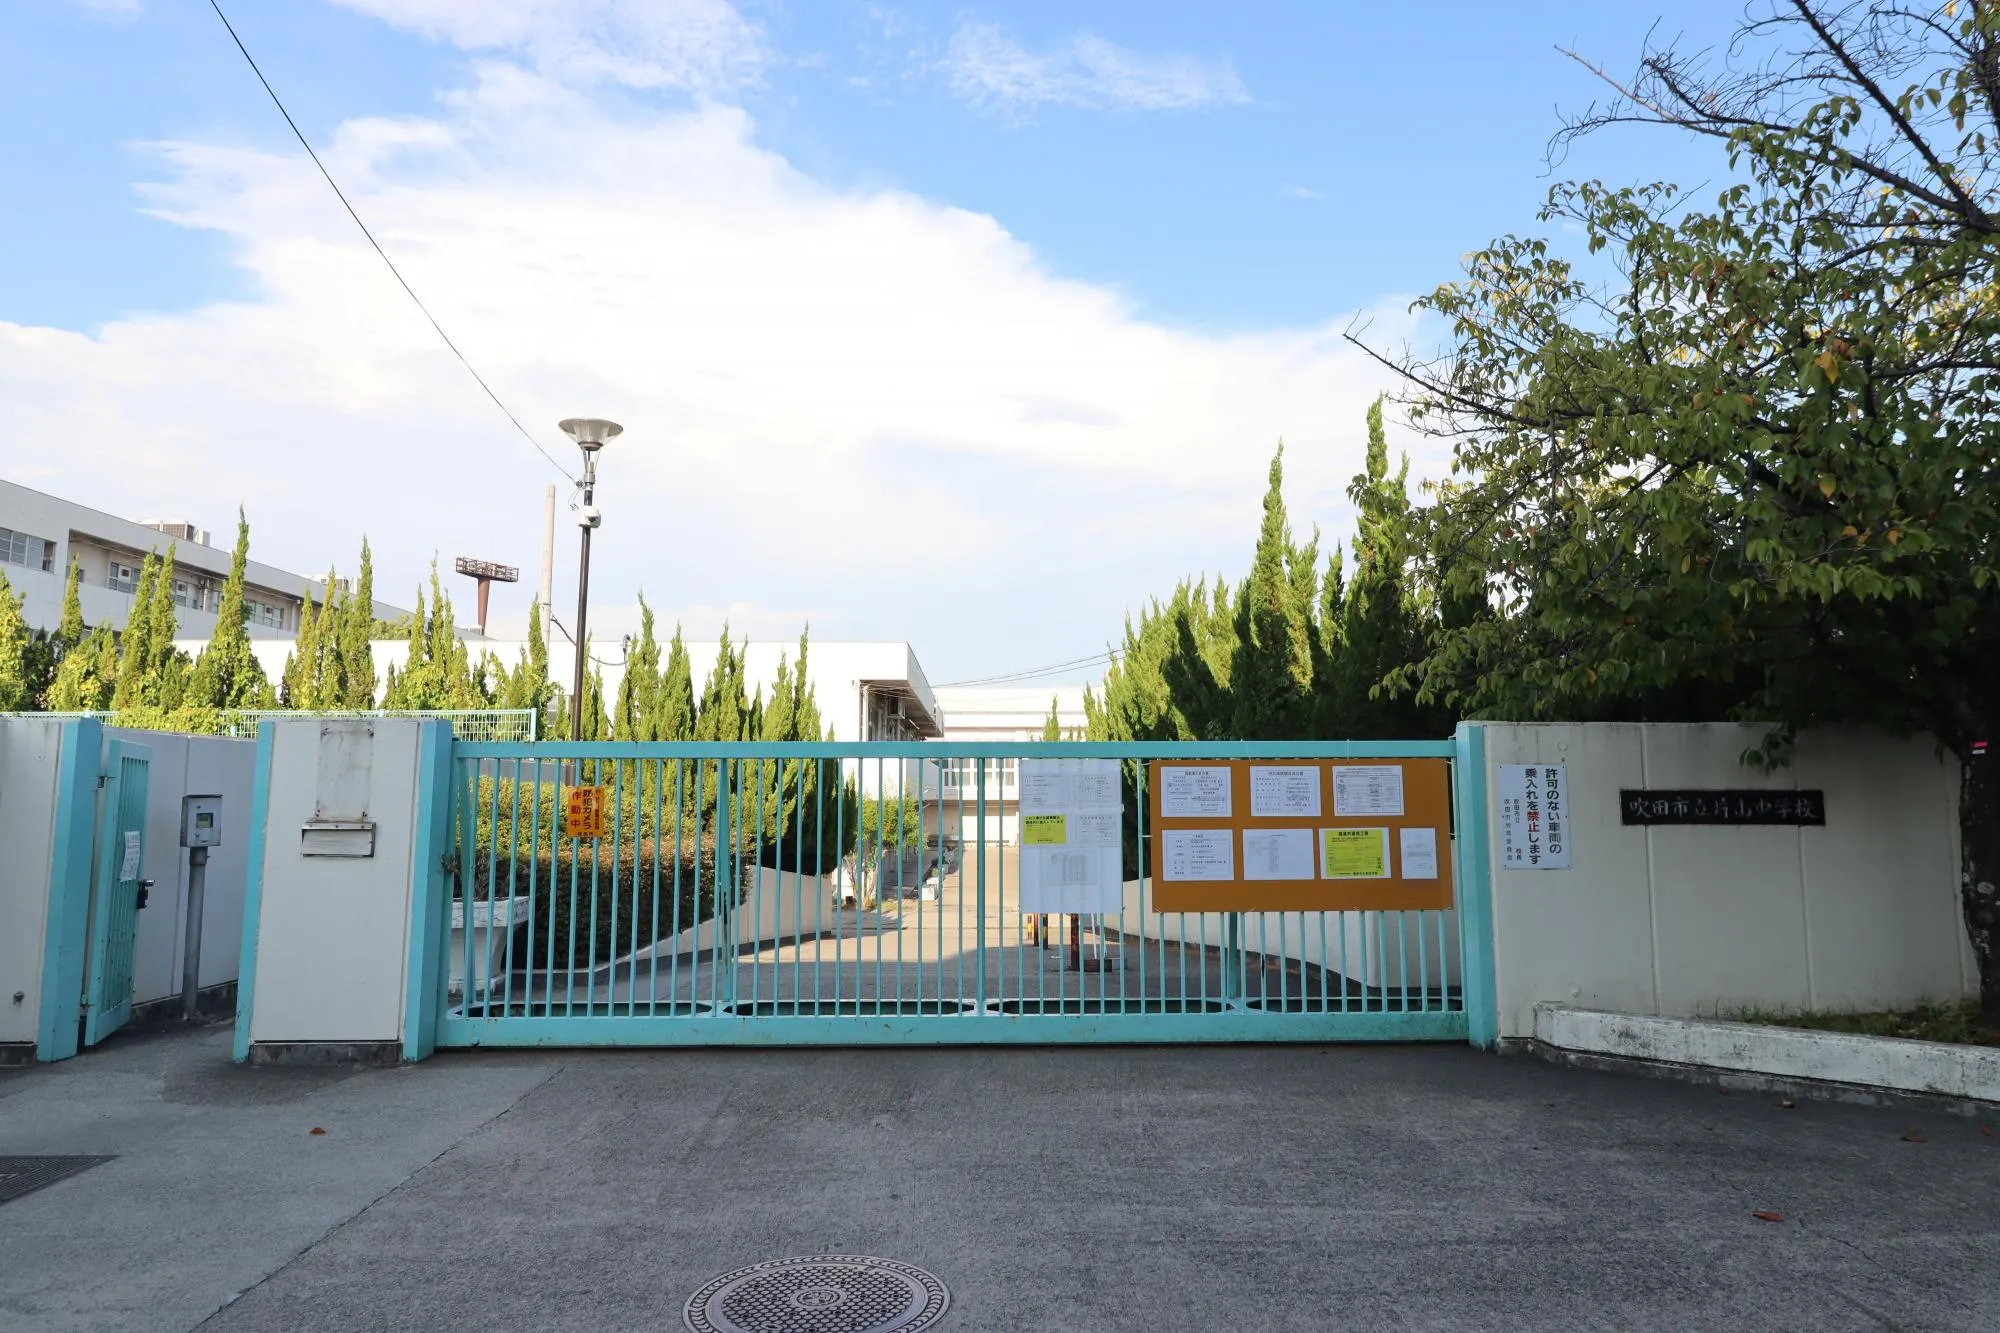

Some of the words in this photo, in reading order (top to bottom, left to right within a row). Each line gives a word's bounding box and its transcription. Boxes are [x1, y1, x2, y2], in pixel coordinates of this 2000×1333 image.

[583, 789, 593, 830] 防犯カメラ
[1525, 768, 1541, 864] 乗入れを禁止します
[1545, 768, 1562, 854] 許可のない車両の
